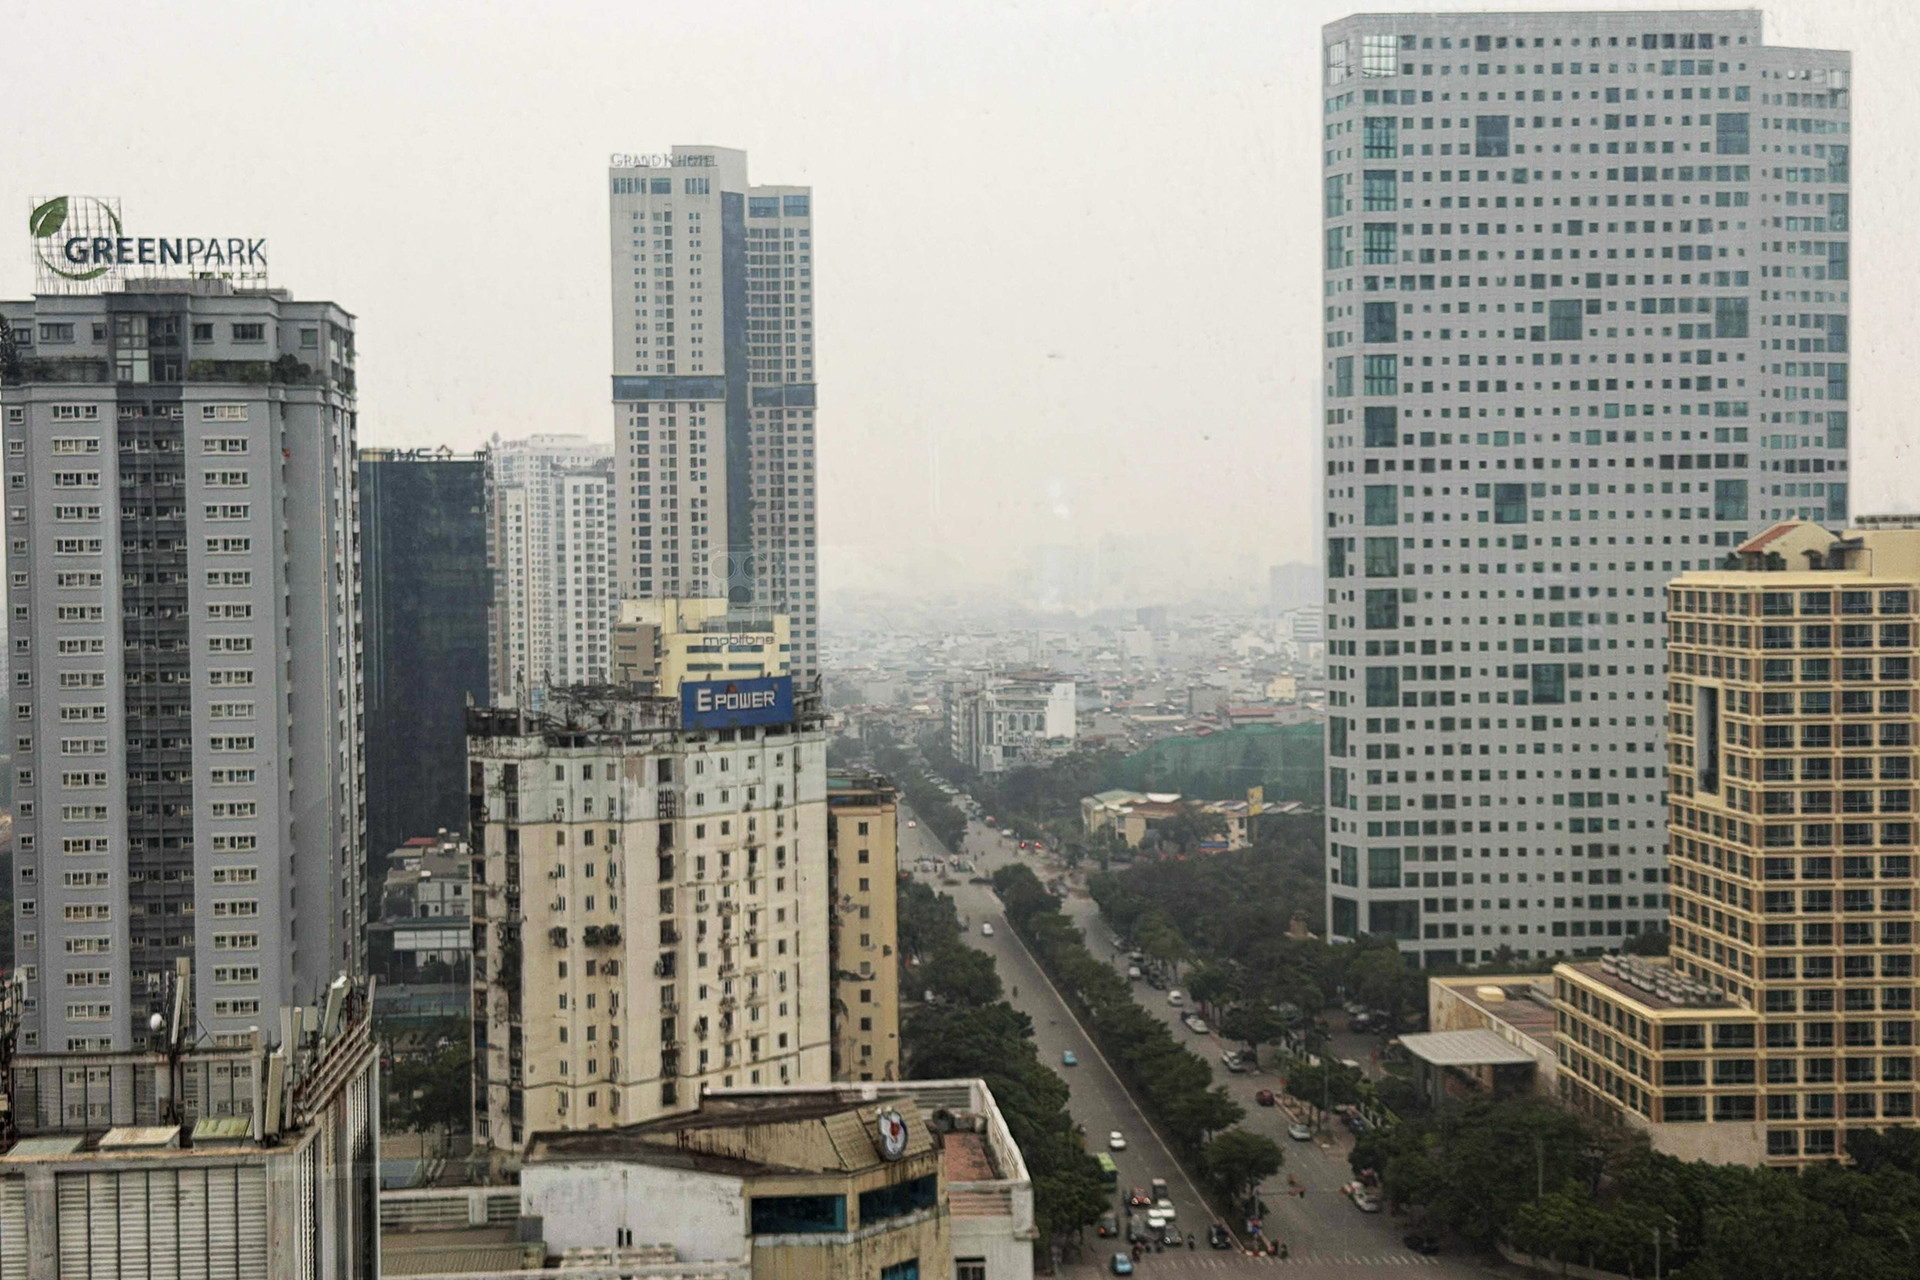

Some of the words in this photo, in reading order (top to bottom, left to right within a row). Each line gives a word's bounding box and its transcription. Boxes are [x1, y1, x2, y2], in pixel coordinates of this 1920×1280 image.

[610, 153, 662, 167] GRAND
[65, 236, 268, 266] GREENPARK
[704, 634, 775, 646] mobifone
[697, 688, 712, 712] E
[715, 690, 776, 710] POWER
